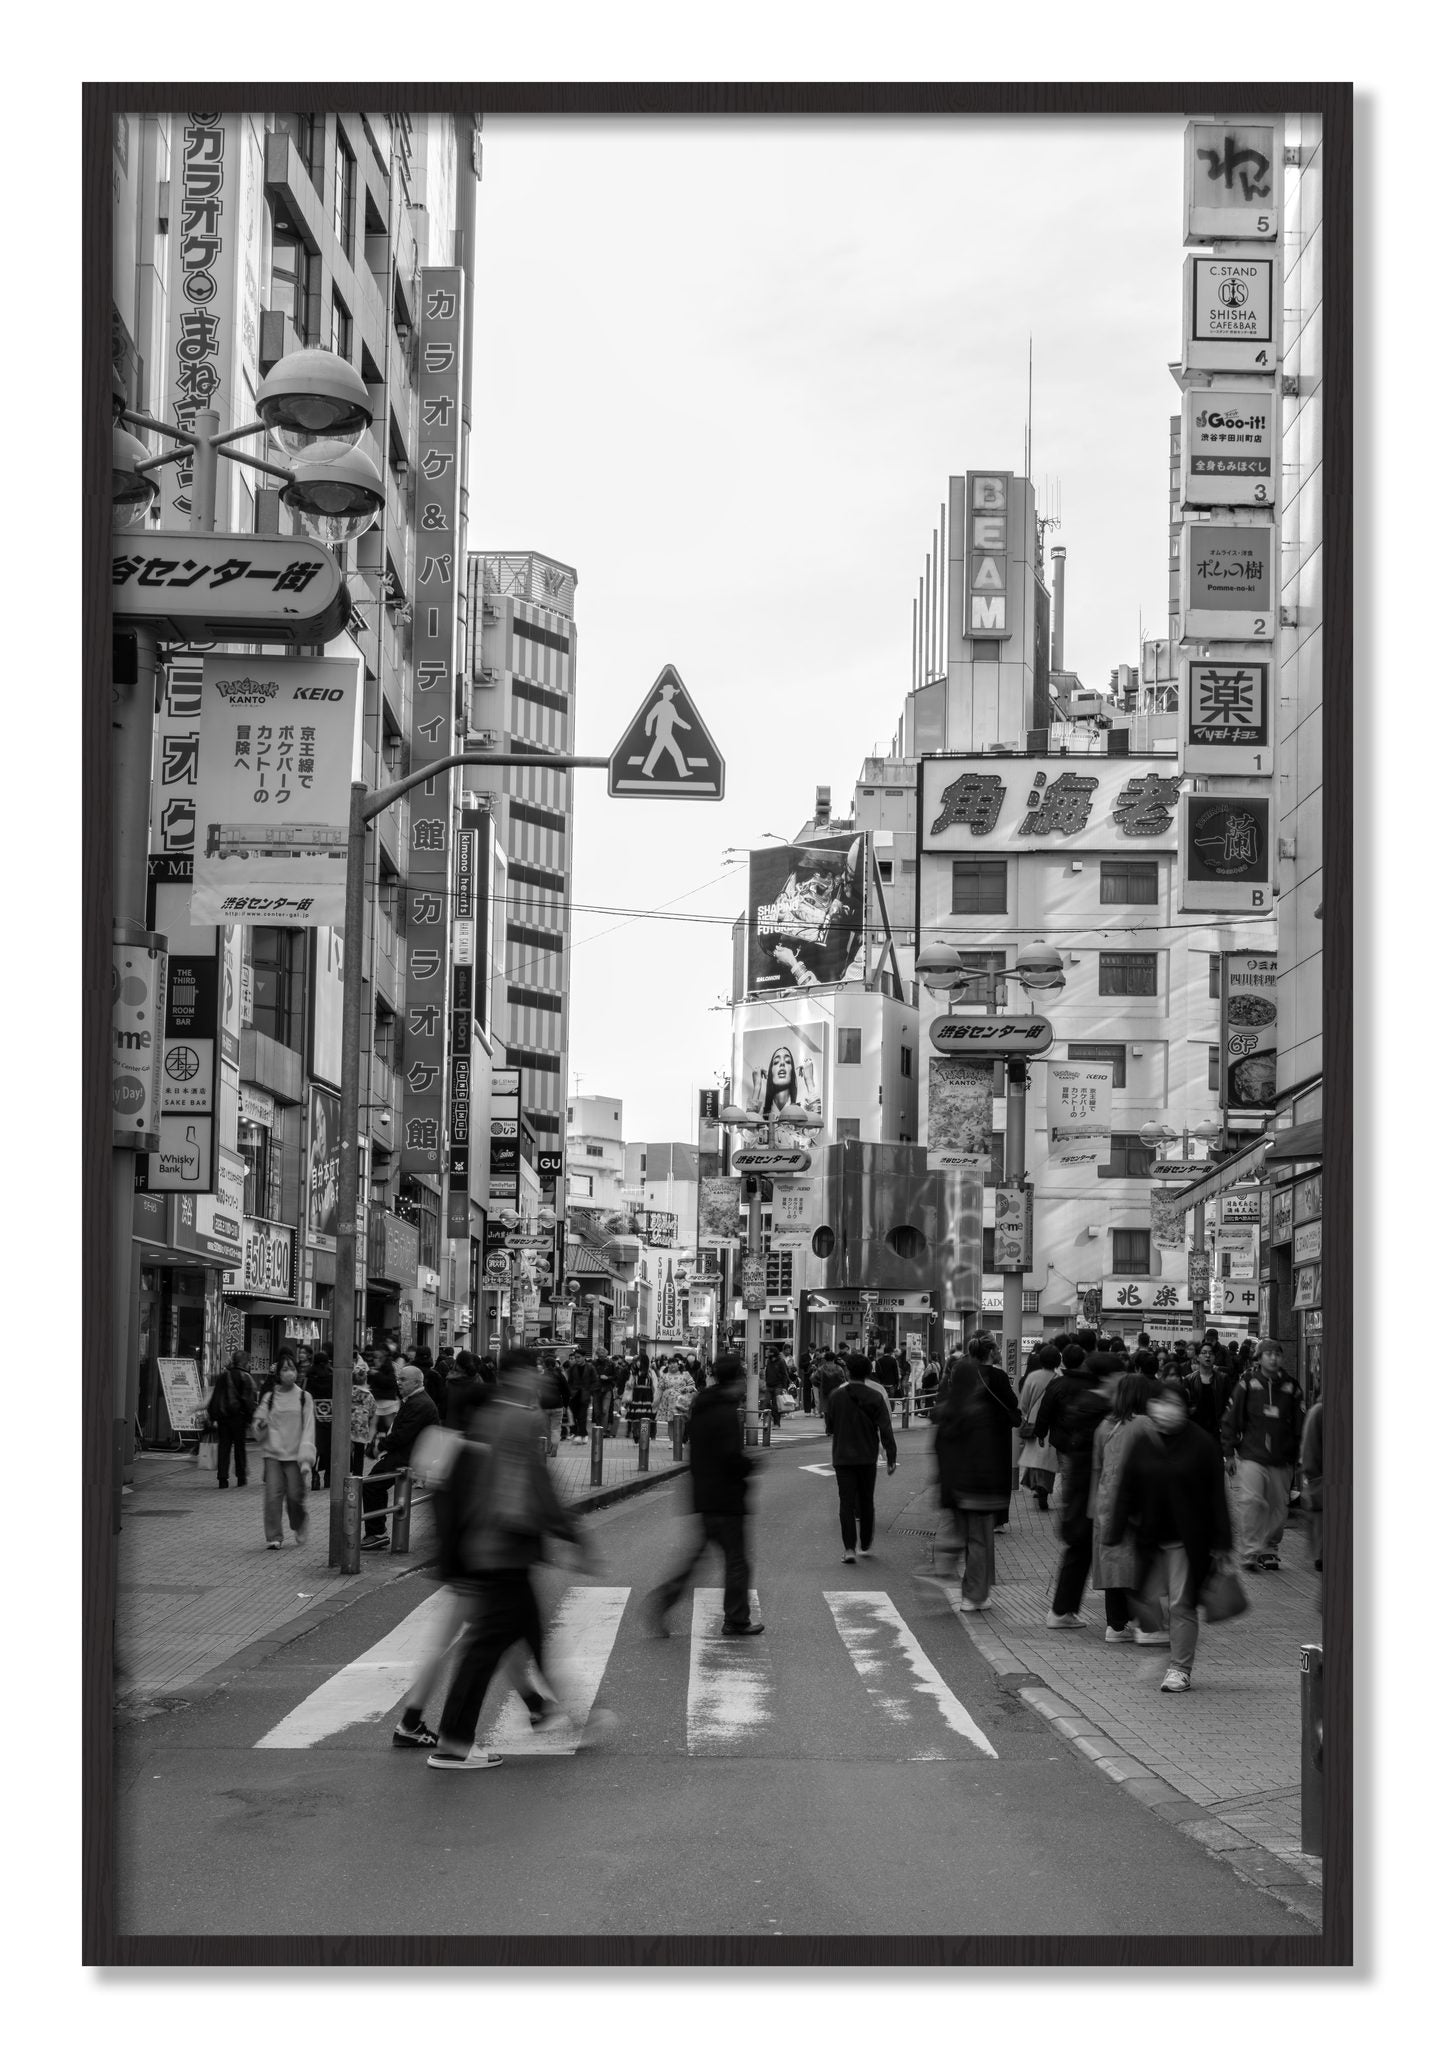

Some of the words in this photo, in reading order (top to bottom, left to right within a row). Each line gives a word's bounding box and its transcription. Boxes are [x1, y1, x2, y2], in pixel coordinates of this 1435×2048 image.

[180, 125, 225, 273] カラオケ
[1256, 216, 1270, 233] 5
[1209, 266, 1258, 277] C.STAND
[1209, 309, 1257, 320] SHISHA
[1209, 321, 1257, 330] CAFE&BAR
[1255, 350, 1268, 366] 4
[1208, 413, 1266, 429] Goo-it!
[1200, 433, 1262, 443] 渋谷宇田川町店
[1195, 460, 1267, 472] 全身もみほぐし
[1254, 484, 1267, 501] 3
[974, 477, 1007, 630] BEAM
[1196, 559, 1264, 579] ポムの樹
[1207, 584, 1255, 592] Pomme-no-ki
[1254, 618, 1266, 635] 2
[293, 687, 344, 701] KEIO
[1200, 669, 1253, 723] 薬
[1194, 727, 1259, 742] マツモトキヨシ
[234, 725, 252, 770] 冒険へ
[254, 725, 272, 803] カントーの
[275, 725, 294, 803] ポケパーク
[298, 726, 315, 788] 京王線で
[1253, 754, 1262, 771] 1
[930, 772, 1183, 836] 角海老
[1194, 813, 1257, 864] 一蘭
[461, 835, 470, 872] kimono
[220, 897, 315, 911] 渋谷センター街
[1252, 889, 1265, 907] B
[1230, 973, 1277, 987] 四川料理
[176, 1018, 191, 1026] BAR
[406, 892, 443, 1150] カラオケ館
[937, 1025, 1046, 1039] 渋谷センター街
[1228, 1034, 1259, 1056] 6F
[122, 1087, 143, 1100] Day!
[1070, 1087, 1078, 1117] カントーの
[160, 1154, 195, 1166] Whisky
[540, 1158, 561, 1169] GU
[735, 1154, 801, 1165] 渋谷センター街
[159, 1165, 180, 1173] Bank
[1117, 1284, 1179, 1307] 兆楽
[665, 1282, 674, 1327] BEER
